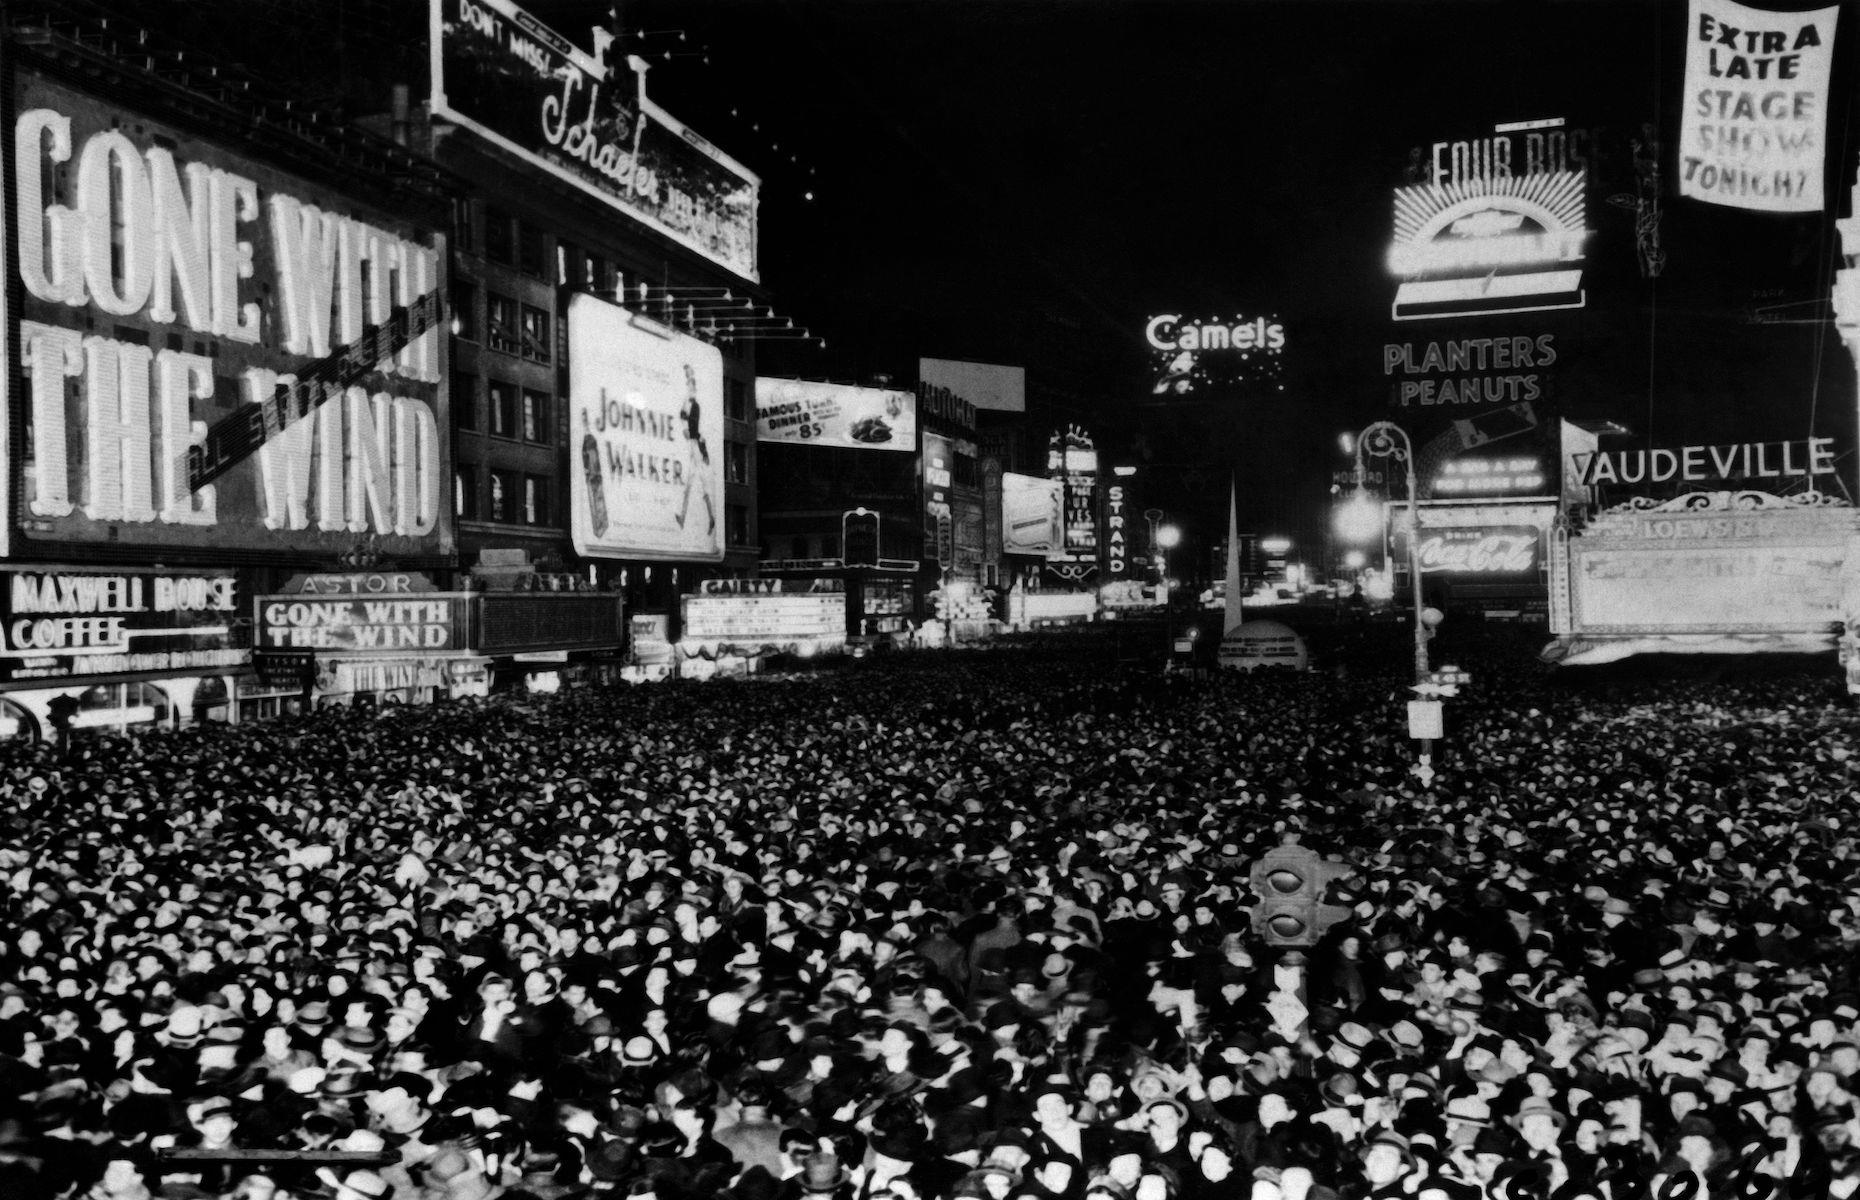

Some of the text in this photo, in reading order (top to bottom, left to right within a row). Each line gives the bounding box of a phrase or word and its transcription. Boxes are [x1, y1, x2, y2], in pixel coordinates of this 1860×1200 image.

[459, 0, 503, 44] DON'T
[1699, 13, 1821, 54] EXTRA
[1709, 48, 1801, 80] LATE
[1697, 89, 1815, 122] STAGE
[1432, 136, 1512, 190] FOUR
[1684, 156, 1808, 198] TONIGHT
[15, 109, 440, 384] GONE WITH
[1146, 314, 1285, 350] Camels
[1383, 335, 1556, 375] PLANTERS
[1401, 375, 1541, 406] PEANUTS
[19, 319, 440, 537] THE WIND
[768, 412, 811, 430] DINNER
[1571, 437, 1836, 486] VAUDEVILLE
[1109, 486, 1126, 573] STRAND
[11, 574, 238, 614] MAXWELL HOUSE
[300, 574, 412, 593] ASTOR
[706, 580, 776, 594] GAIETY
[265, 601, 449, 627] GONE WITH
[11, 617, 130, 650] COFFEE
[267, 625, 448, 649] THE WIND
